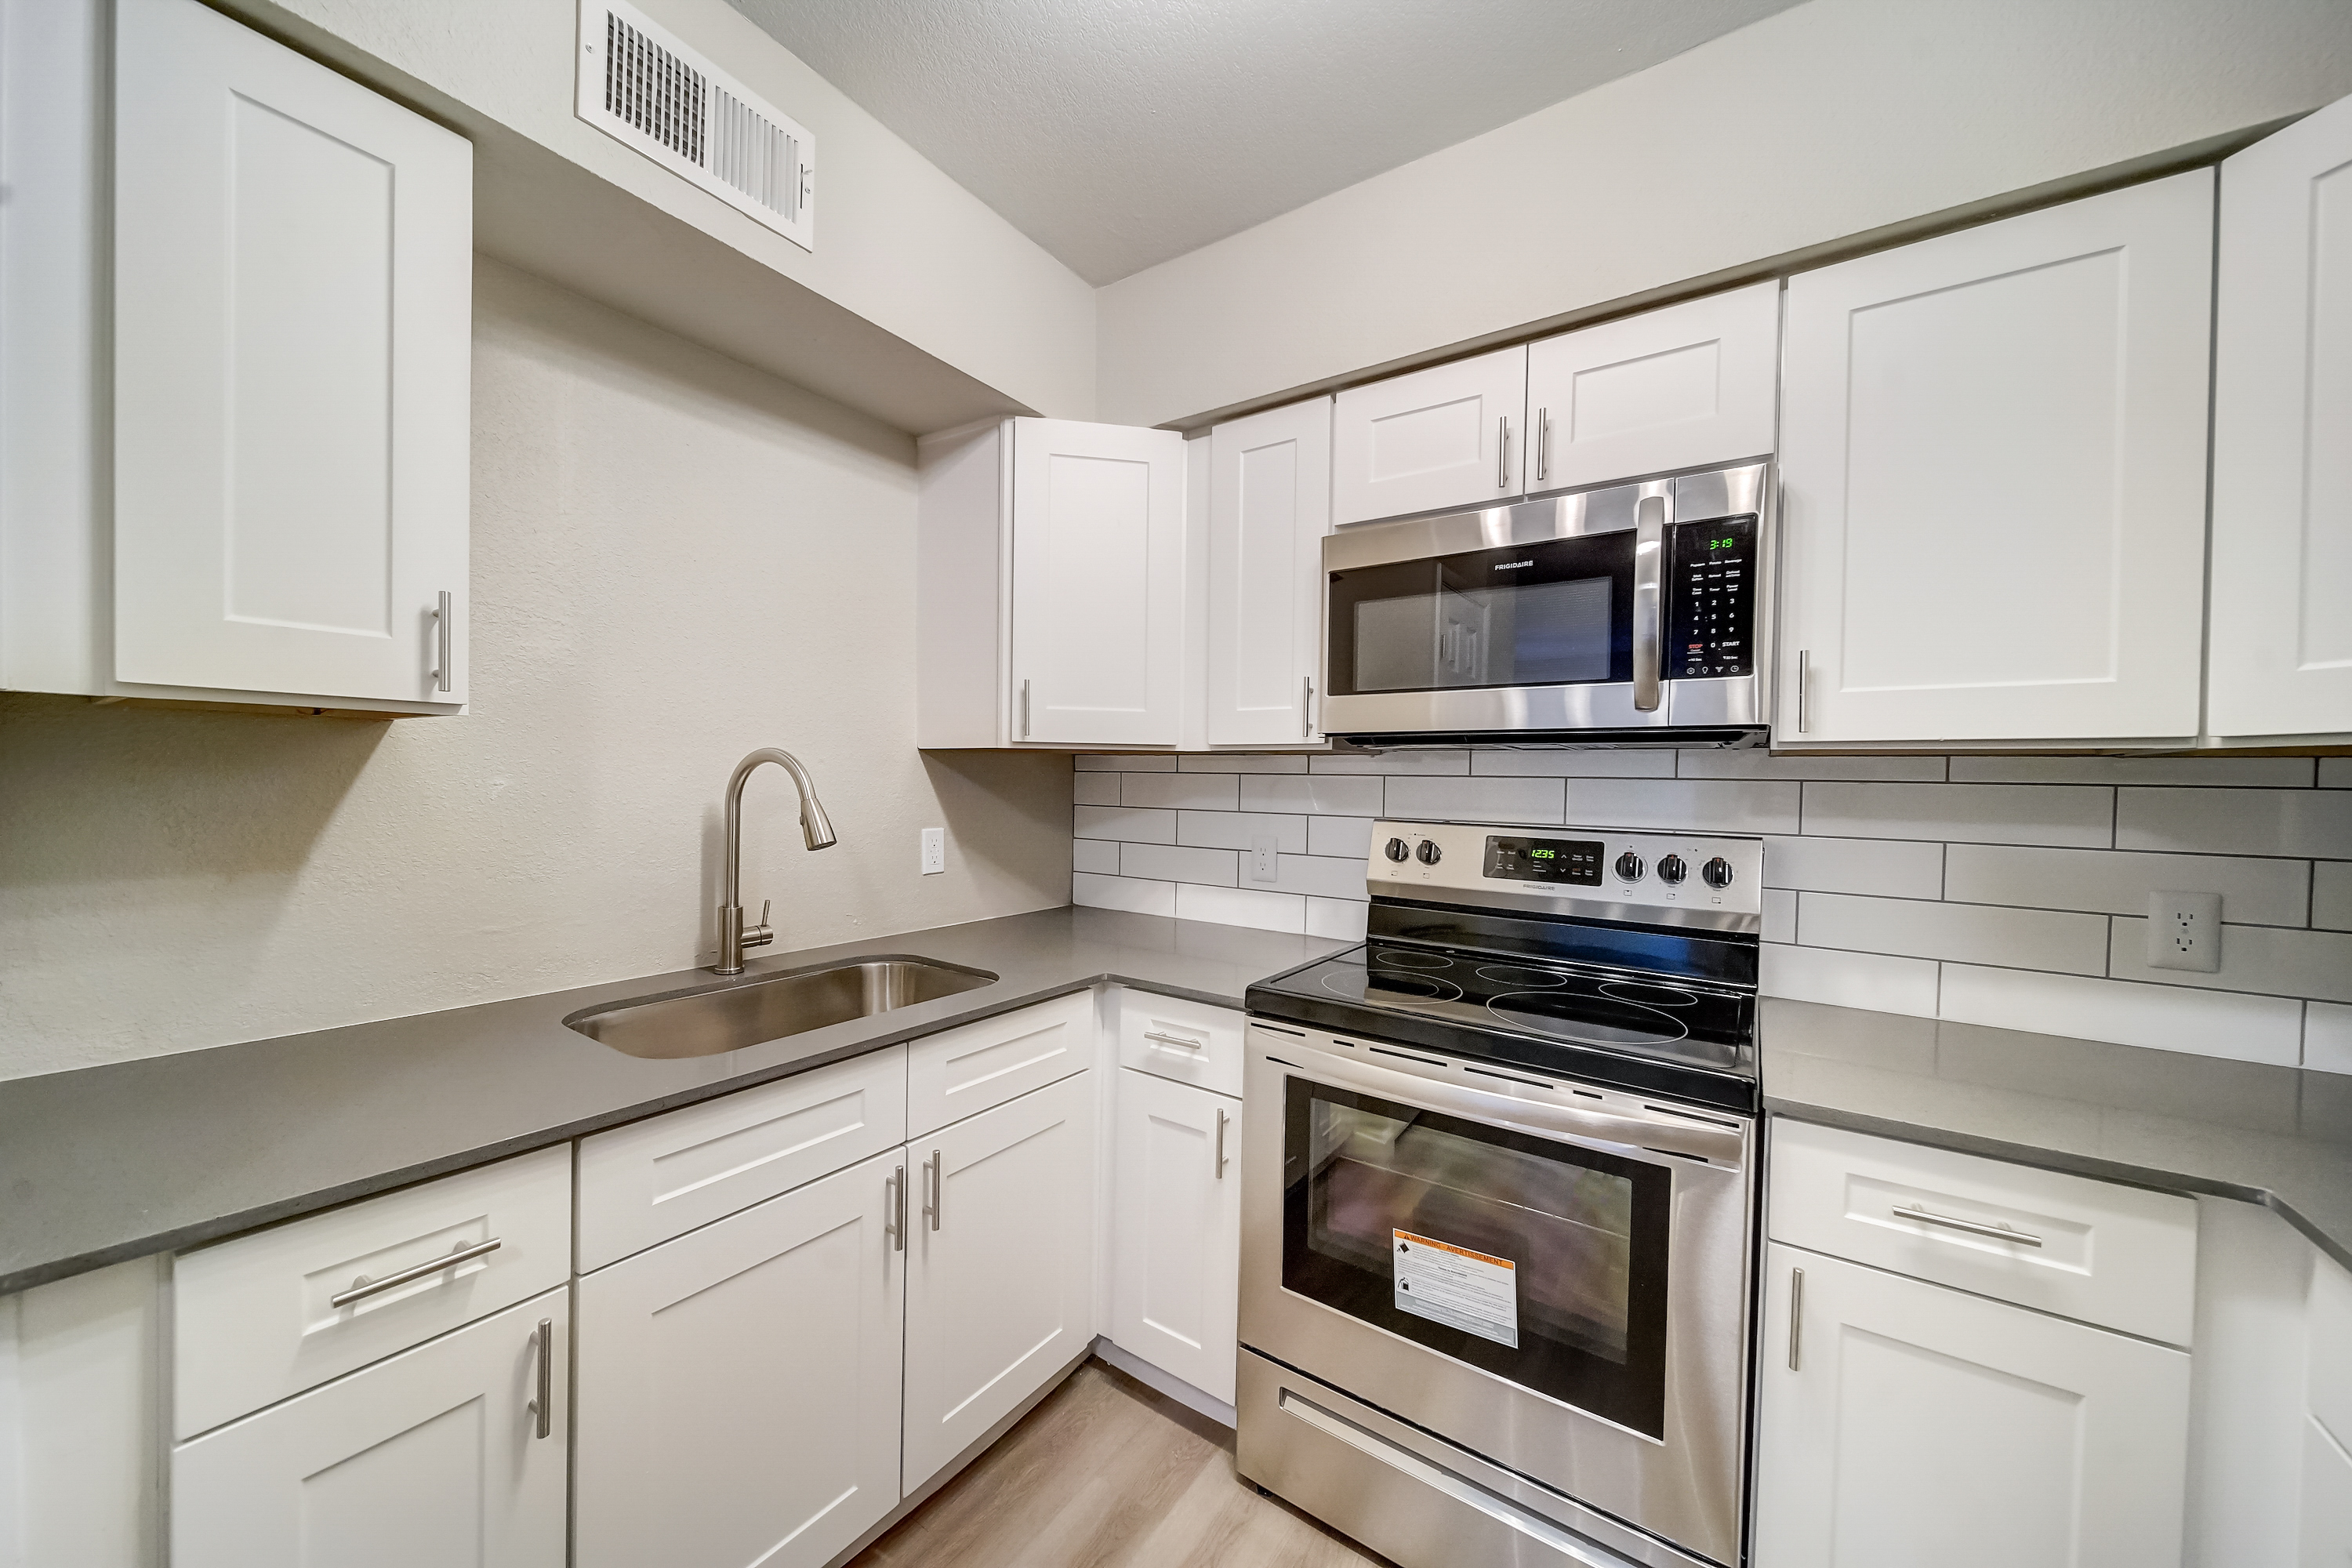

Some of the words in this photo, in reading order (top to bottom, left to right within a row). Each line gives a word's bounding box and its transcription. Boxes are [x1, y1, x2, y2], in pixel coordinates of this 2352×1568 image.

[1710, 538, 1733, 550] 3:19
[1494, 560, 1534, 571] FRIGIDAIRE
[1410, 1235, 1441, 1248] WARNING
[1446, 1244, 1504, 1266] AVERTISSEMENT
